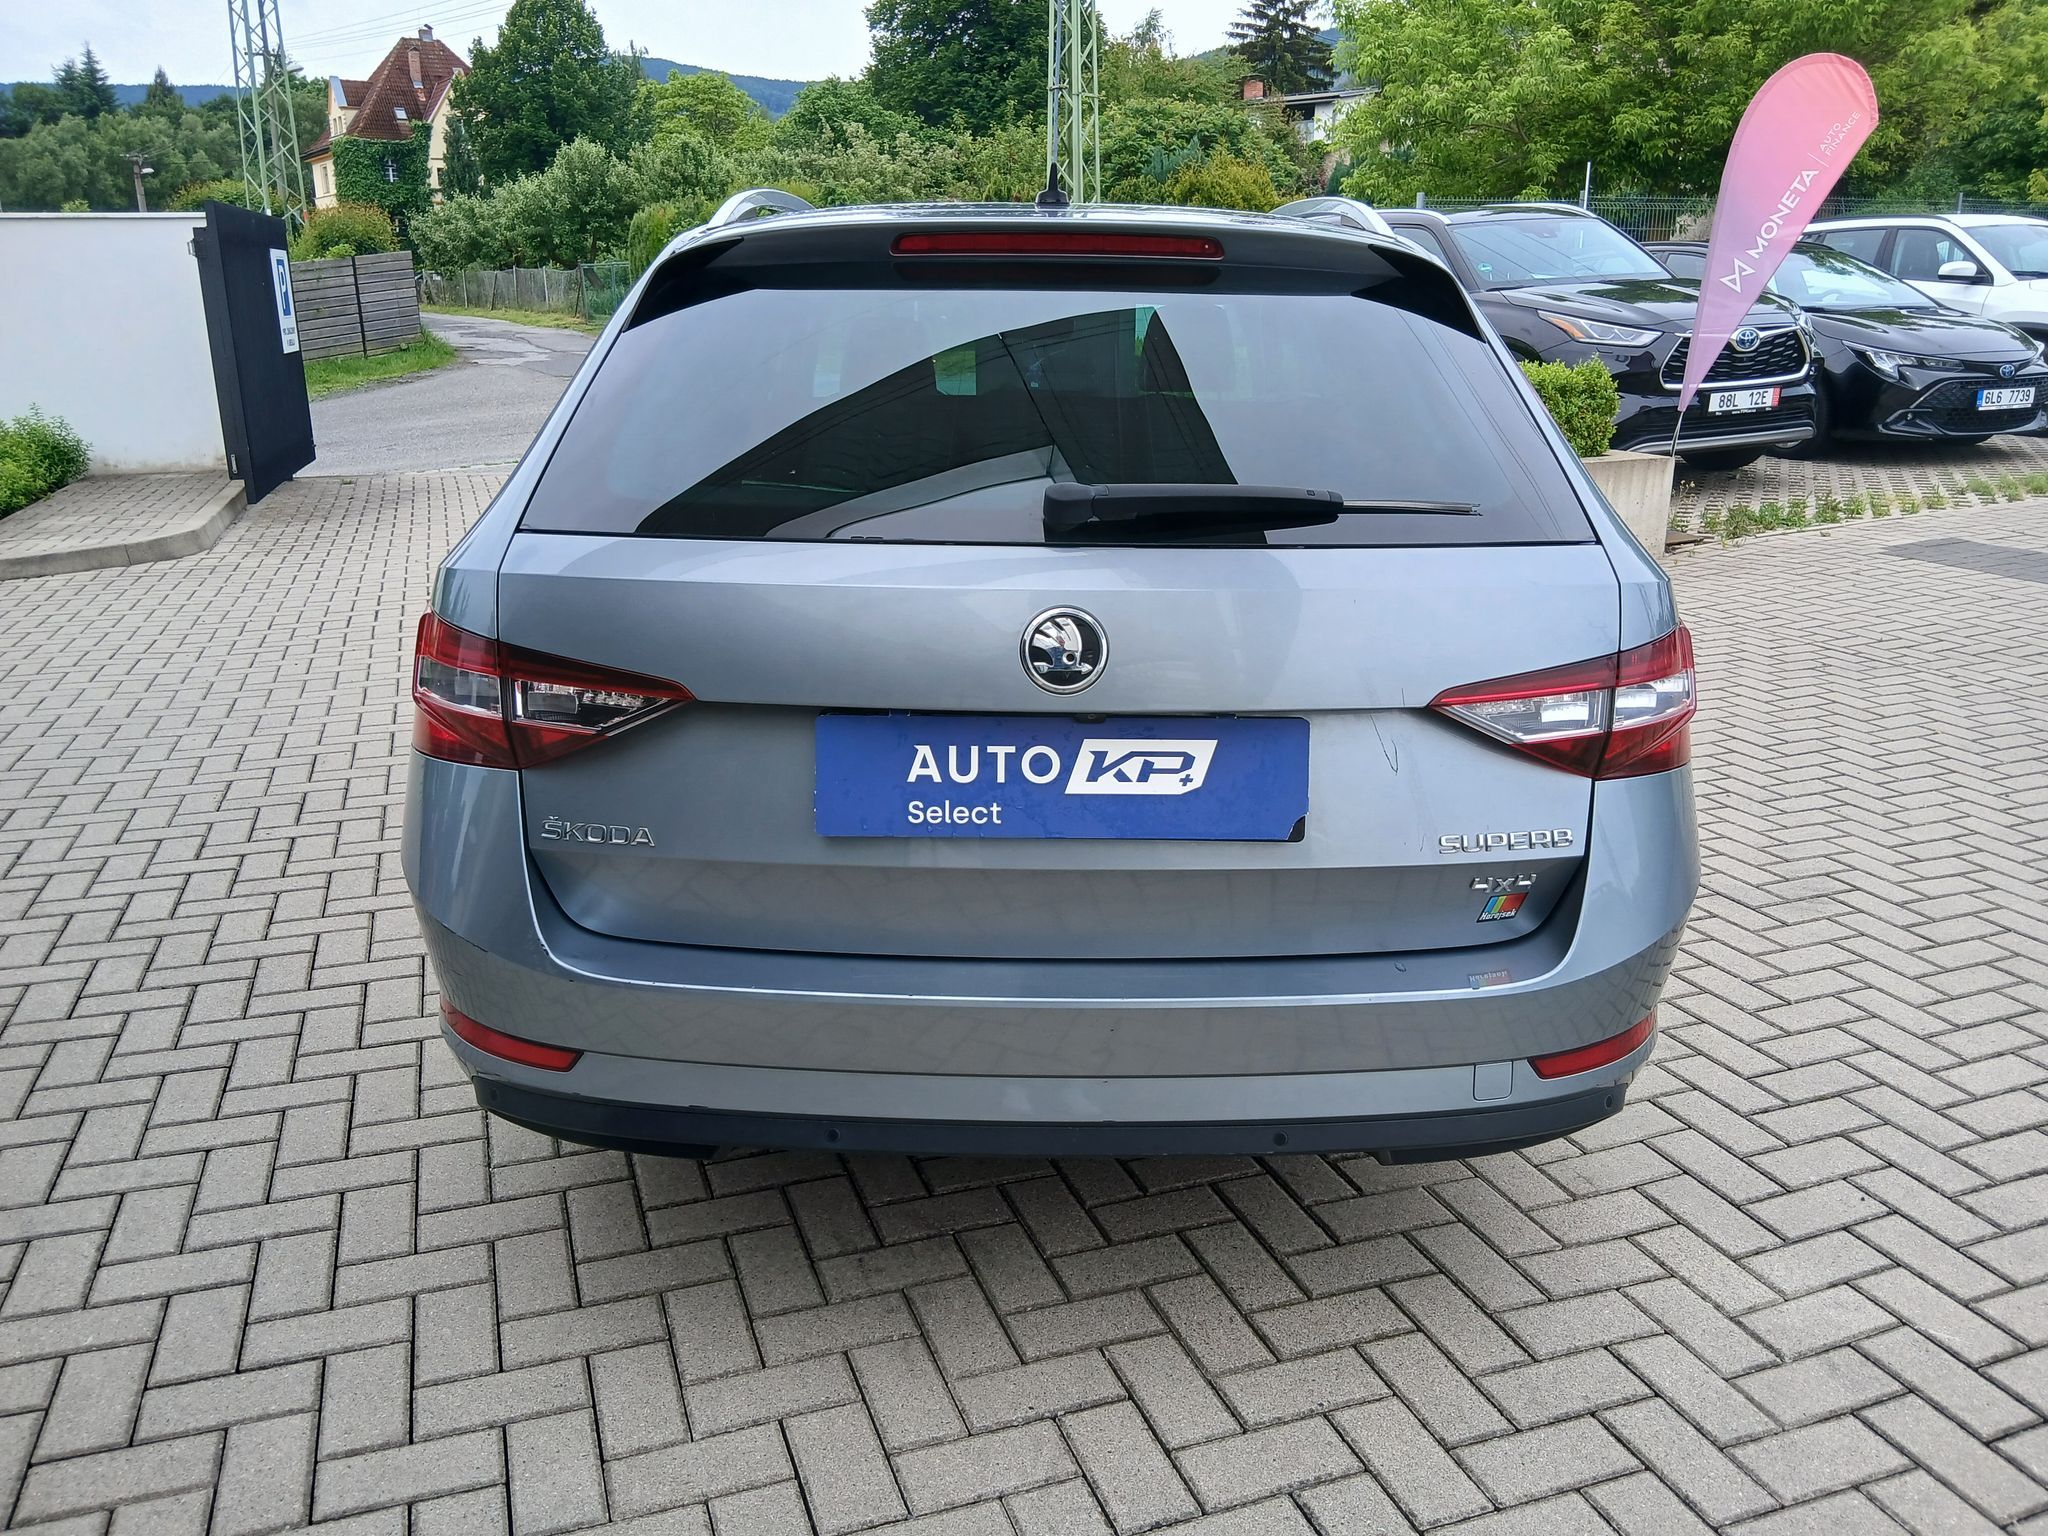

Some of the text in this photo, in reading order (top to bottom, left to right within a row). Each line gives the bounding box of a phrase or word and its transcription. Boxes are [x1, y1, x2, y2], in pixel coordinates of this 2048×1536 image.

[1820, 122, 1841, 152] AUTO
[1825, 111, 1861, 156] FINANCE
[1745, 169, 1820, 259] MONETA
[278, 265, 287, 309] P
[1718, 390, 1769, 408] 88L 12E
[1984, 389, 2031, 405] 6L6 7739
[906, 745, 1061, 784] AUTO
[907, 800, 1002, 825] Select
[540, 815, 656, 848] ŠKODA
[1439, 828, 1573, 854] SUPERB
